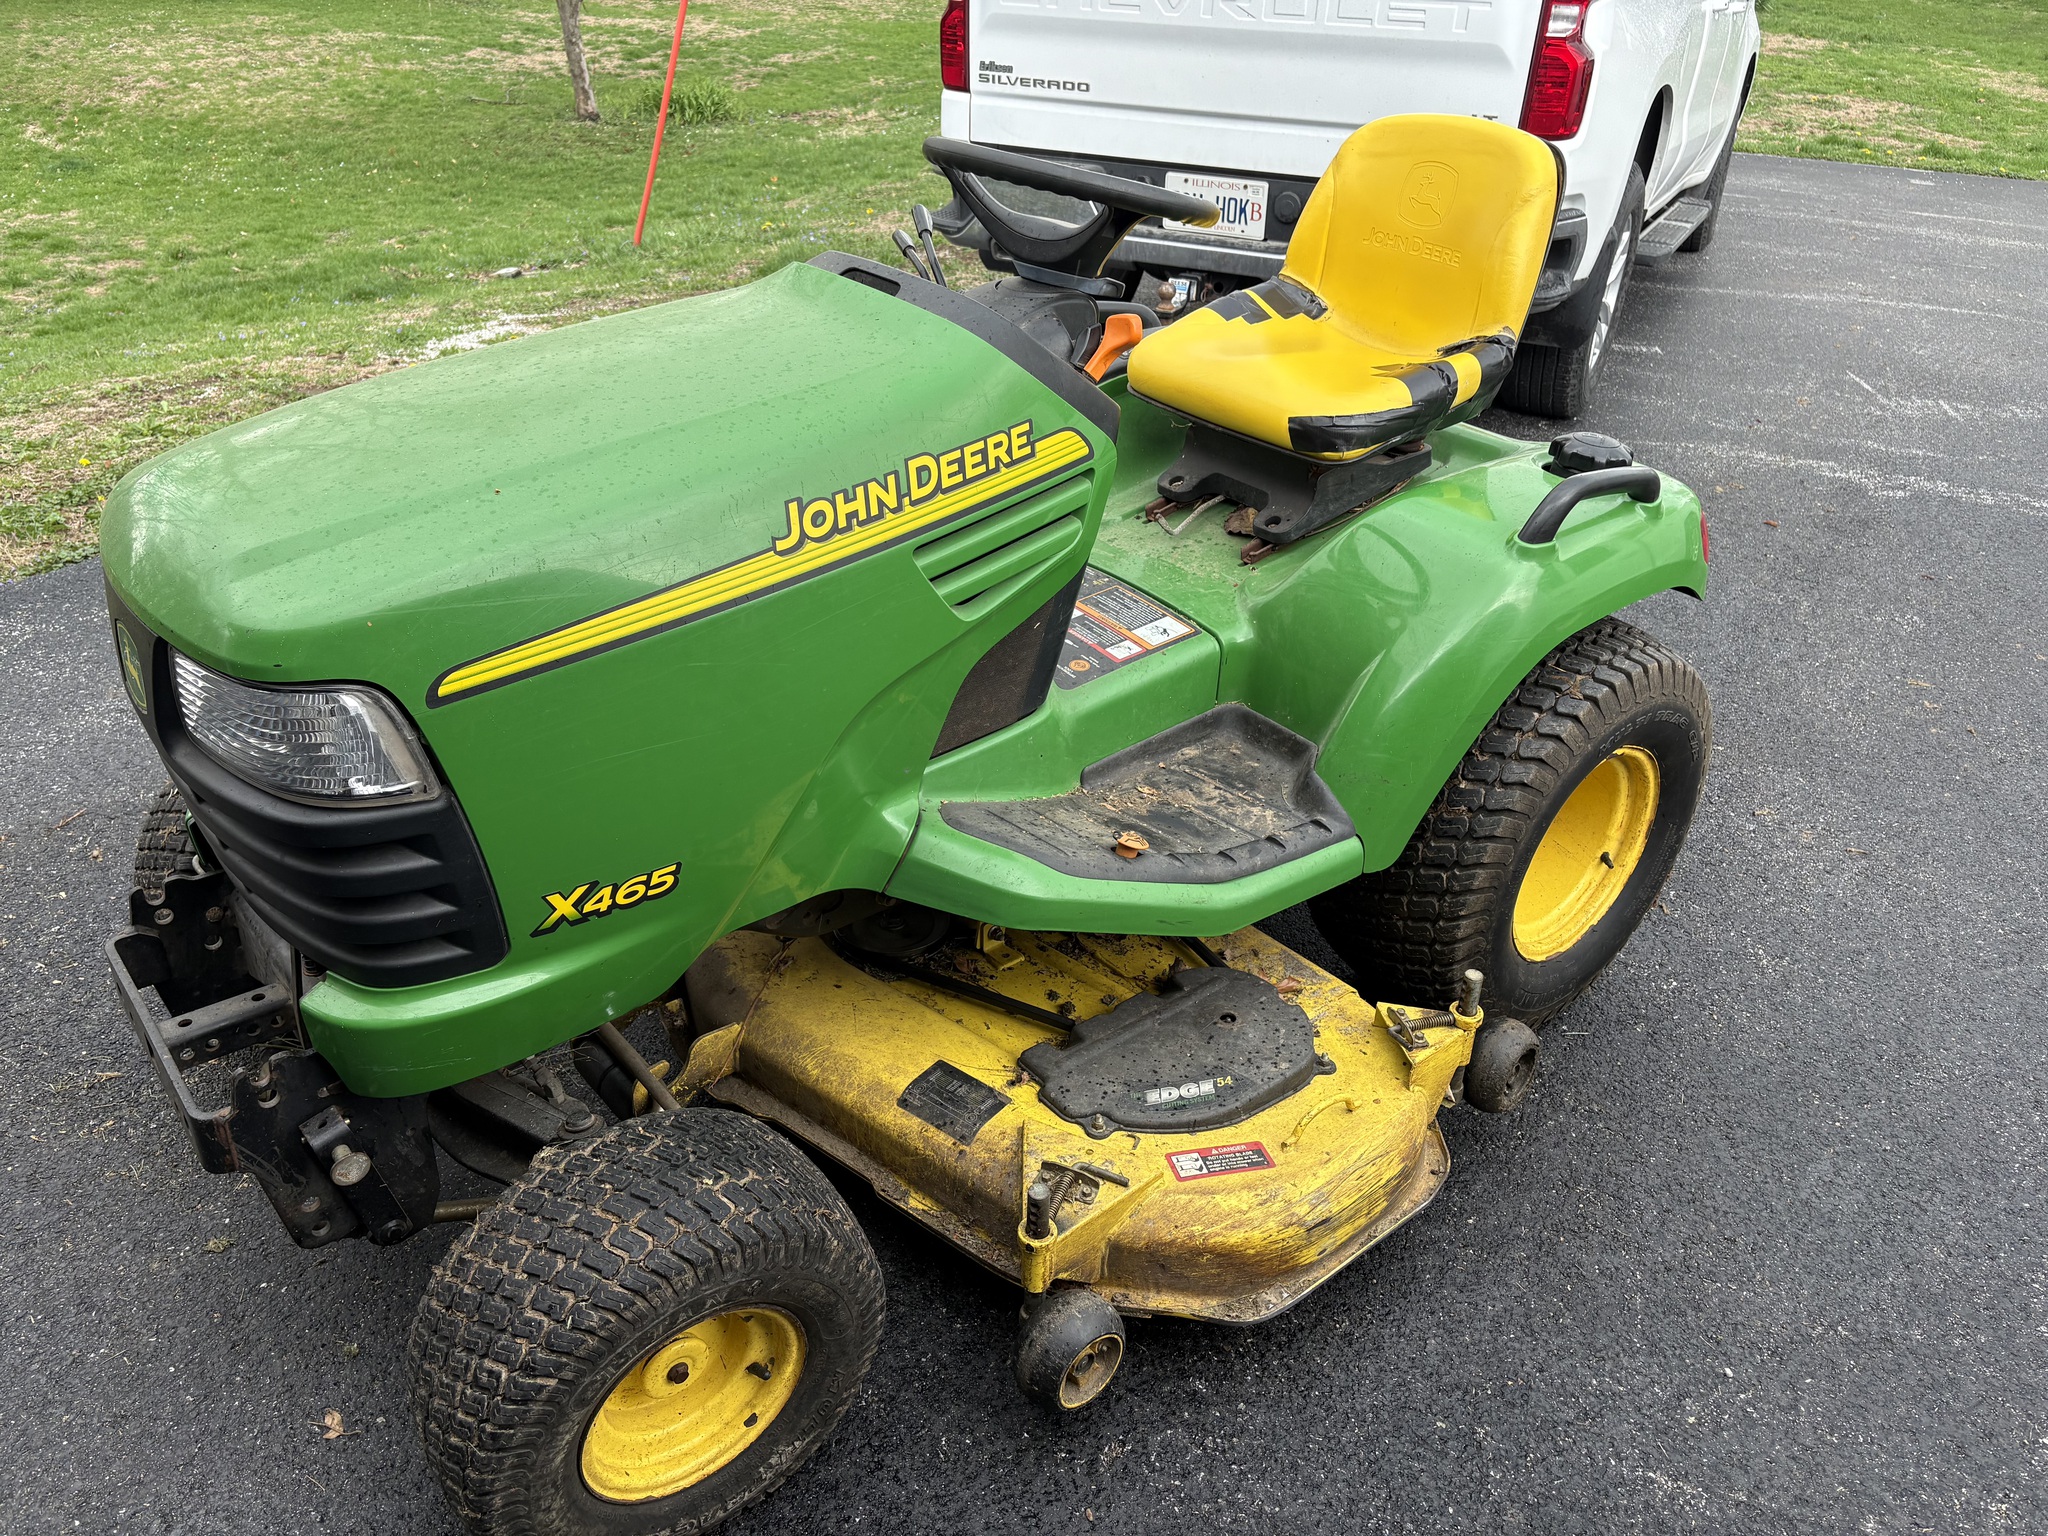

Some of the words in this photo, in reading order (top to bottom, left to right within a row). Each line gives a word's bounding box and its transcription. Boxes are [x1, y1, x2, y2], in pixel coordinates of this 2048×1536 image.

[998, 0, 1492, 33] VROLET
[978, 73, 1090, 92] SILVERADO
[1191, 178, 1241, 191] ILLINOIS
[1361, 226, 1409, 254] JOHN
[1408, 235, 1462, 268] DEERE
[772, 471, 899, 555] JOHN
[905, 420, 1032, 502] DEERE
[531, 862, 681, 937] X465
[1143, 1079, 1216, 1106] EDGE
[1216, 1075, 1233, 1087] 54
[1190, 1094, 1216, 1106] SYSTEM
[1218, 1144, 1247, 1154] DANGER
